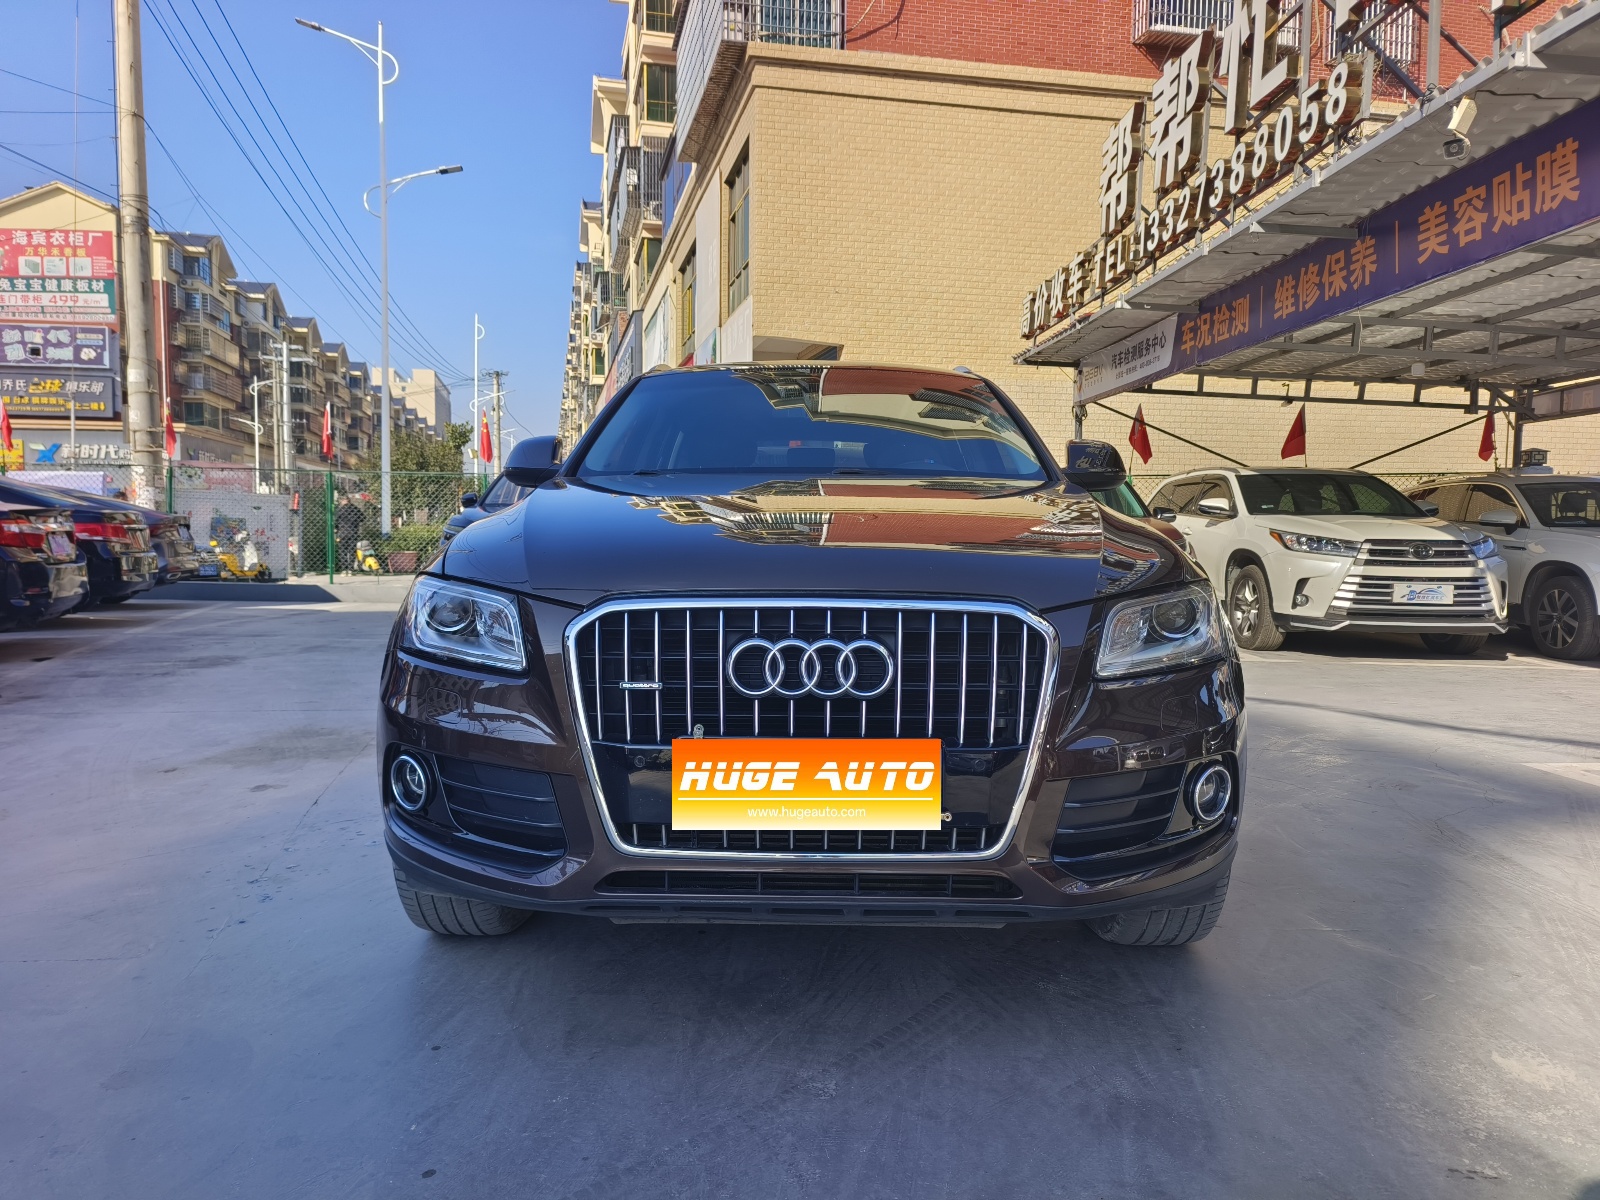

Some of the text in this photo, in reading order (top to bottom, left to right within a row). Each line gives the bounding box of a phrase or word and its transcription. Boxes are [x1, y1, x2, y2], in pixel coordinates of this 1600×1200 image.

[1099, 0, 1360, 235] 帮帮忙
[12, 230, 103, 247] 海宾衣柜厂
[1181, 137, 1581, 355] 车况检测 维修保养 美容贴膜
[0, 278, 105, 292] 兔宝宝健康板材
[1020, 252, 1085, 337] 高价收车
[48, 295, 79, 305] 499
[1111, 331, 1167, 370] 汽车检测服务中心
[0, 377, 105, 396] 乔氏台球俱乐部
